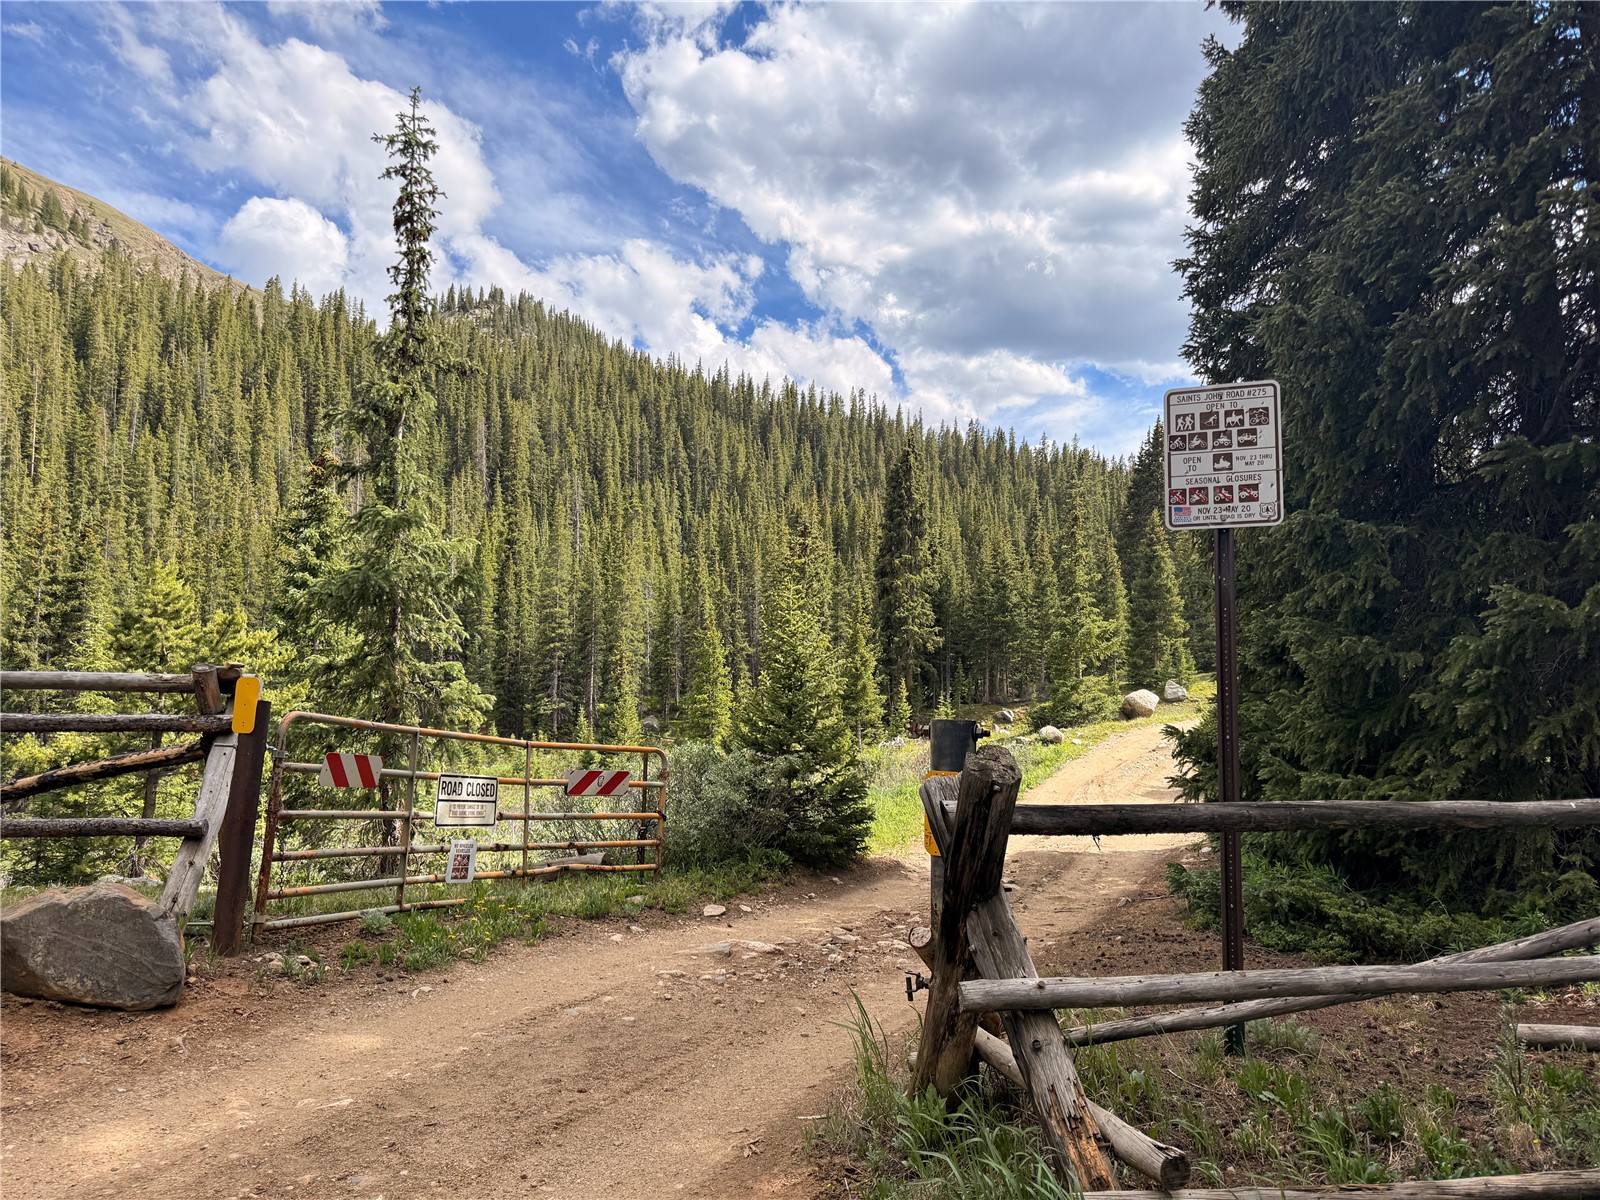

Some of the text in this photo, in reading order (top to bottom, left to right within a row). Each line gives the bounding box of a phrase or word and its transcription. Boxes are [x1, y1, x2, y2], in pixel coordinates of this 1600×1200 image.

[1176, 394, 1201, 404] SAINTS
[1226, 389, 1245, 399] ROAD
[1247, 387, 1267, 397] #275
[1206, 401, 1238, 411] OPEN TO
[1182, 456, 1202, 465] OPEN
[1188, 464, 1197, 472] TO
[1185, 473, 1262, 486] SEASONAL CLOSURES
[1197, 506, 1211, 515] NOV
[1202, 514, 1218, 522] UNTIL
[1244, 512, 1256, 520] DRY
[441, 780, 495, 798] ROAD CLOSED
